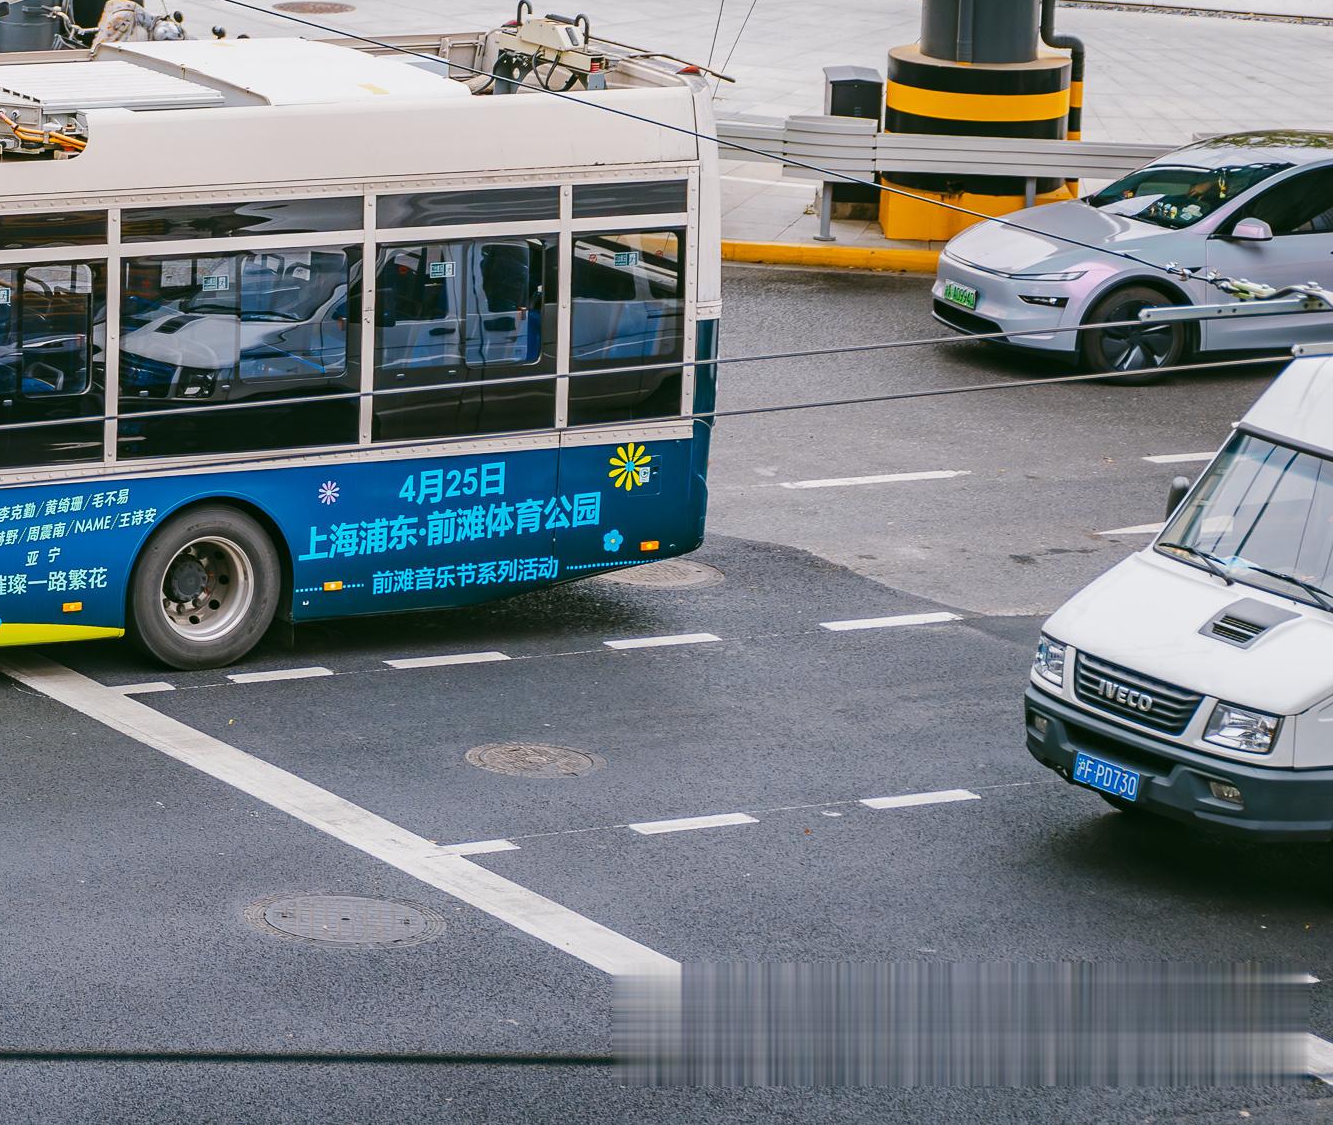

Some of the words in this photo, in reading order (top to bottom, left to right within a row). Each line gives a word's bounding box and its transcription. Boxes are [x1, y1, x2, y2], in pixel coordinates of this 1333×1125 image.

[399, 461, 507, 505] 4月25日
[298, 491, 602, 562] 上海浦东·前滩体育公园
[25, 550, 40, 567] 亚
[47, 547, 61, 564] 宁
[372, 556, 559, 595] 前滩音乐节系列活动
[1098, 679, 1153, 712] IVECO
